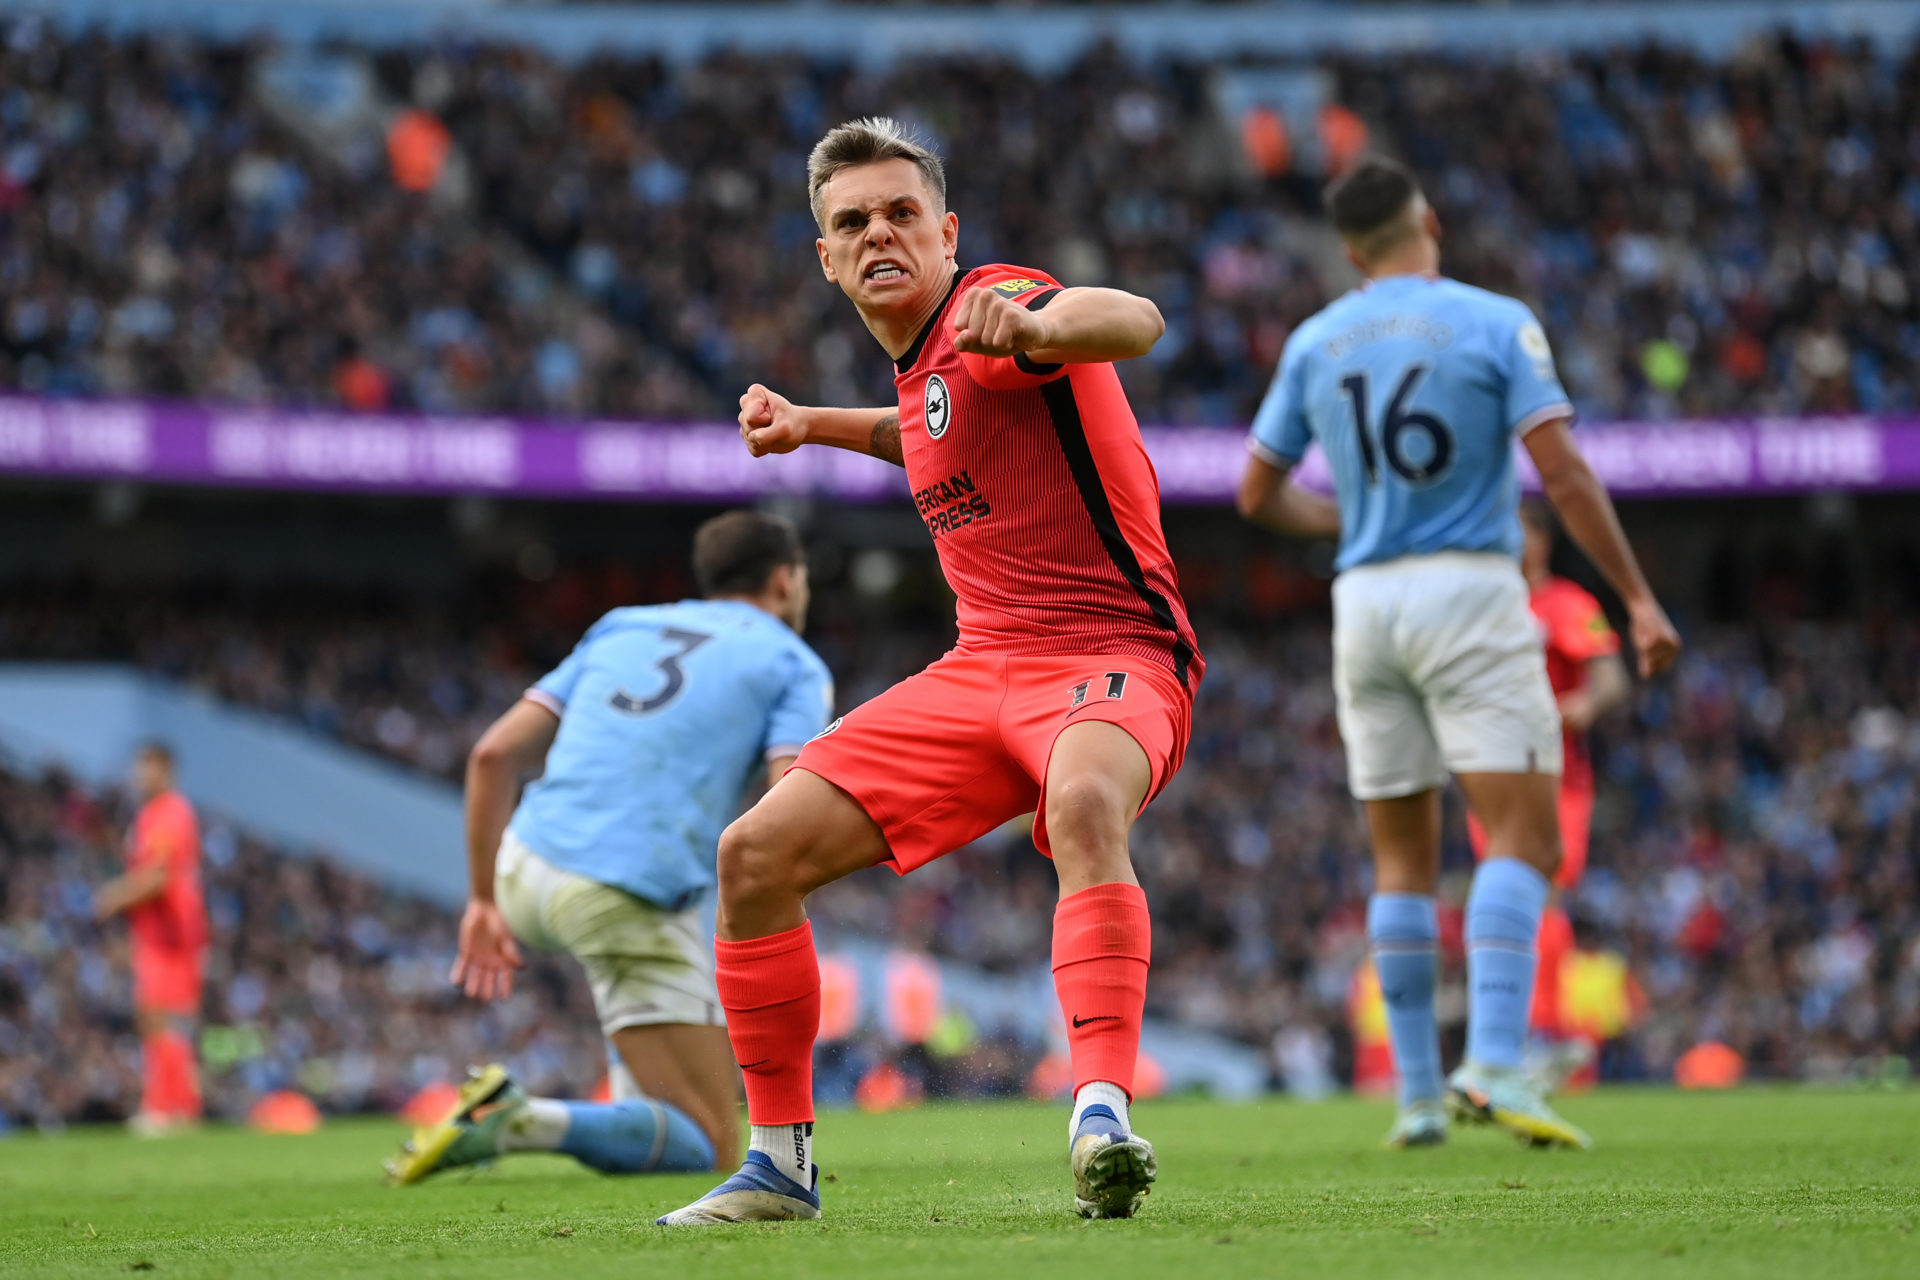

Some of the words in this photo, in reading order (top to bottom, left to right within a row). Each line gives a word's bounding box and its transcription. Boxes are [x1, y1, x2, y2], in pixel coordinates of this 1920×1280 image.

[1340, 363, 1454, 483] 16
[926, 494, 991, 540] PRESS
[610, 626, 715, 714] 3
[1067, 672, 1128, 708] 11
[793, 1123, 806, 1171] ESIGN
